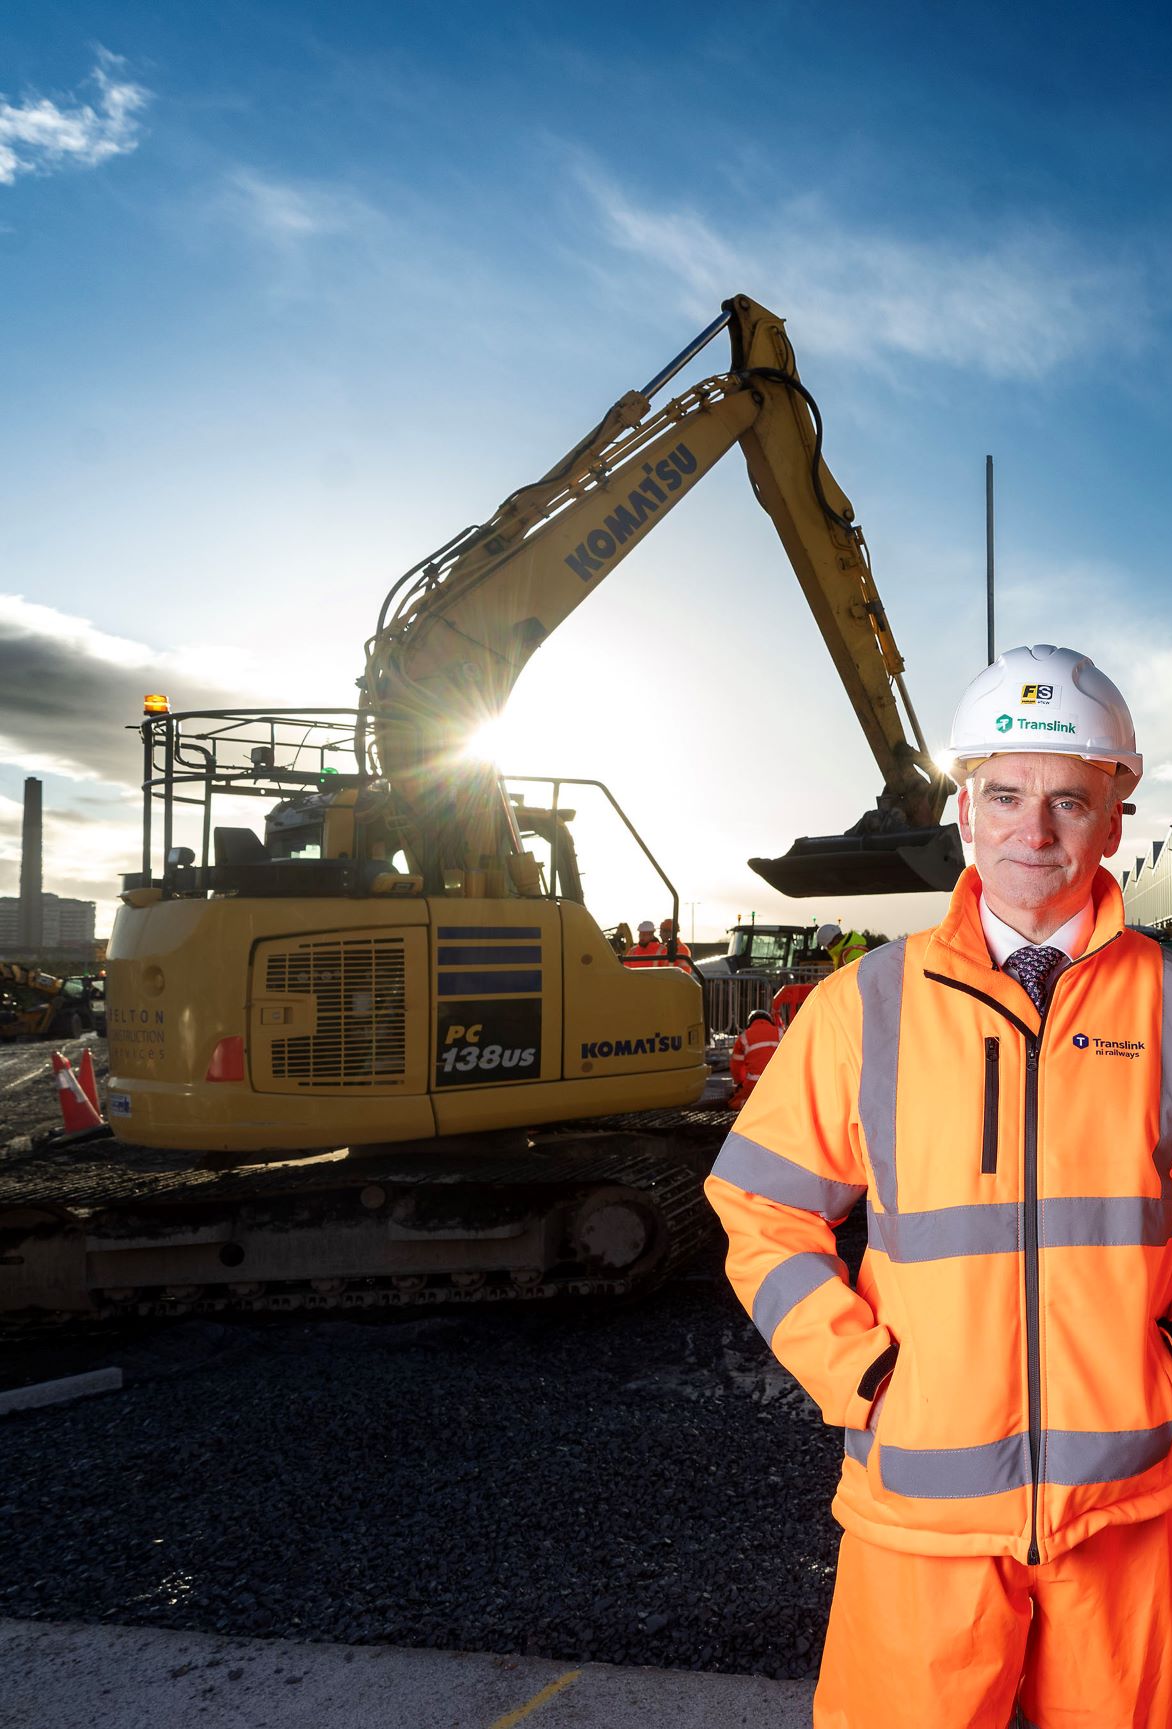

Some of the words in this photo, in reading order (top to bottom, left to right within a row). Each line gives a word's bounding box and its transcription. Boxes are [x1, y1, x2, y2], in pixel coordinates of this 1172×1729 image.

[564, 442, 697, 583] KOMATSU
[1017, 718, 1077, 734] Translink
[444, 1024, 483, 1044] PC
[581, 1032, 682, 1059] KOMATSU
[1093, 1038, 1145, 1050] Translink
[1105, 1050, 1140, 1059] railways
